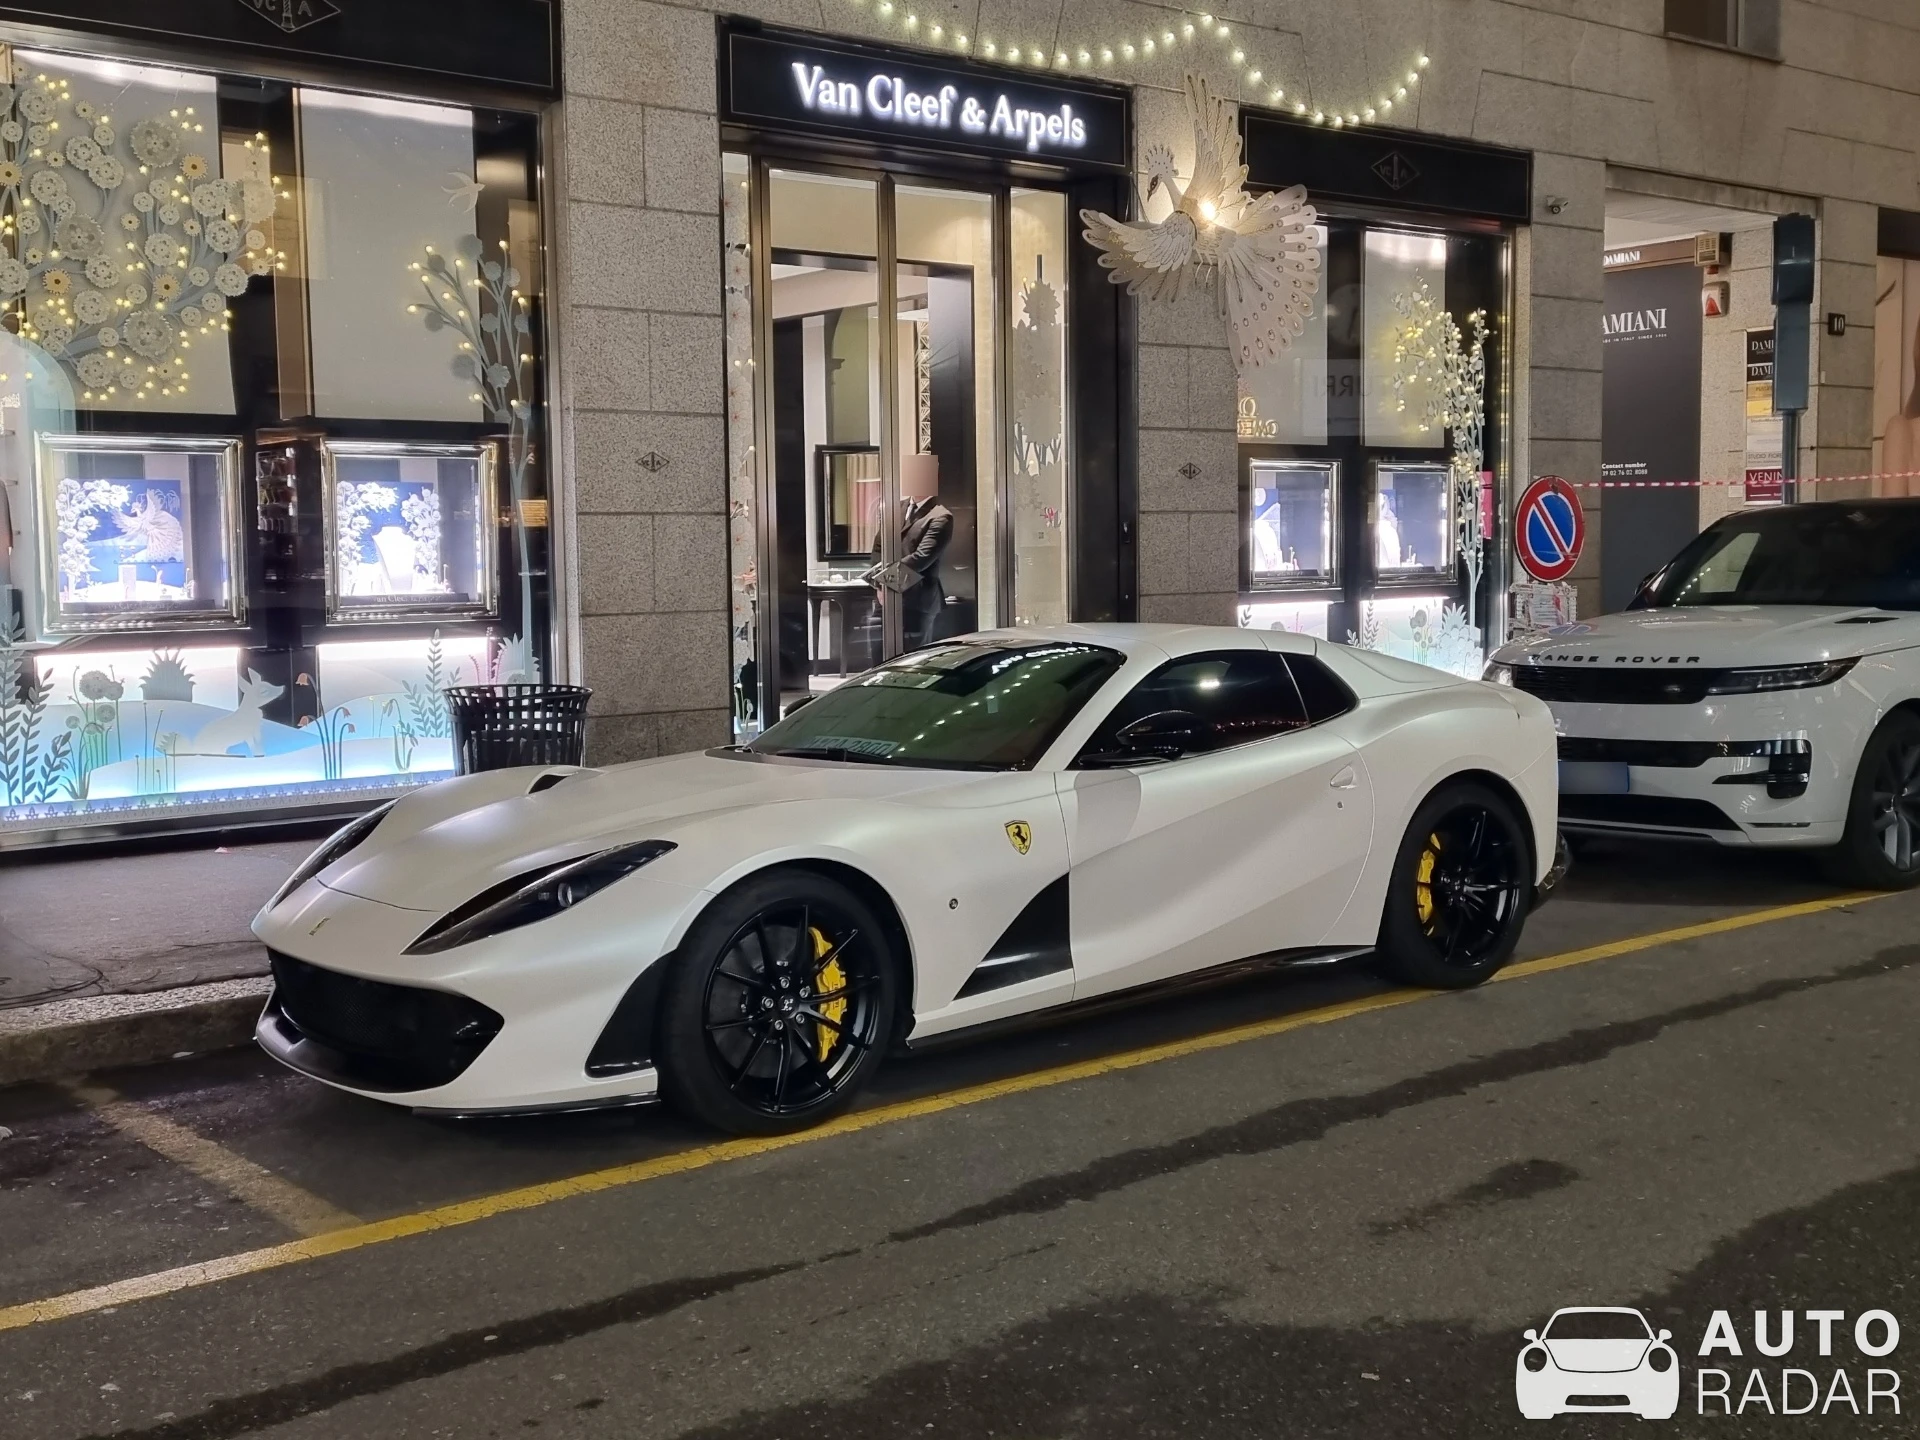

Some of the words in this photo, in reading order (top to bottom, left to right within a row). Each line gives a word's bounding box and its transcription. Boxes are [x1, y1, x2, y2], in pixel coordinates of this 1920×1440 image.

[791, 61, 859, 113] Van
[867, 73, 958, 126] Cleef
[961, 96, 987, 131] &
[989, 93, 1087, 151] Arpels
[1603, 250, 1641, 267] DAMIANI
[1602, 307, 1668, 335] AMIANI
[1834, 316, 1844, 331] 10
[1751, 339, 1774, 351] DAMI
[1751, 365, 1774, 376] DAMI
[1749, 470, 1783, 482] VENIN
